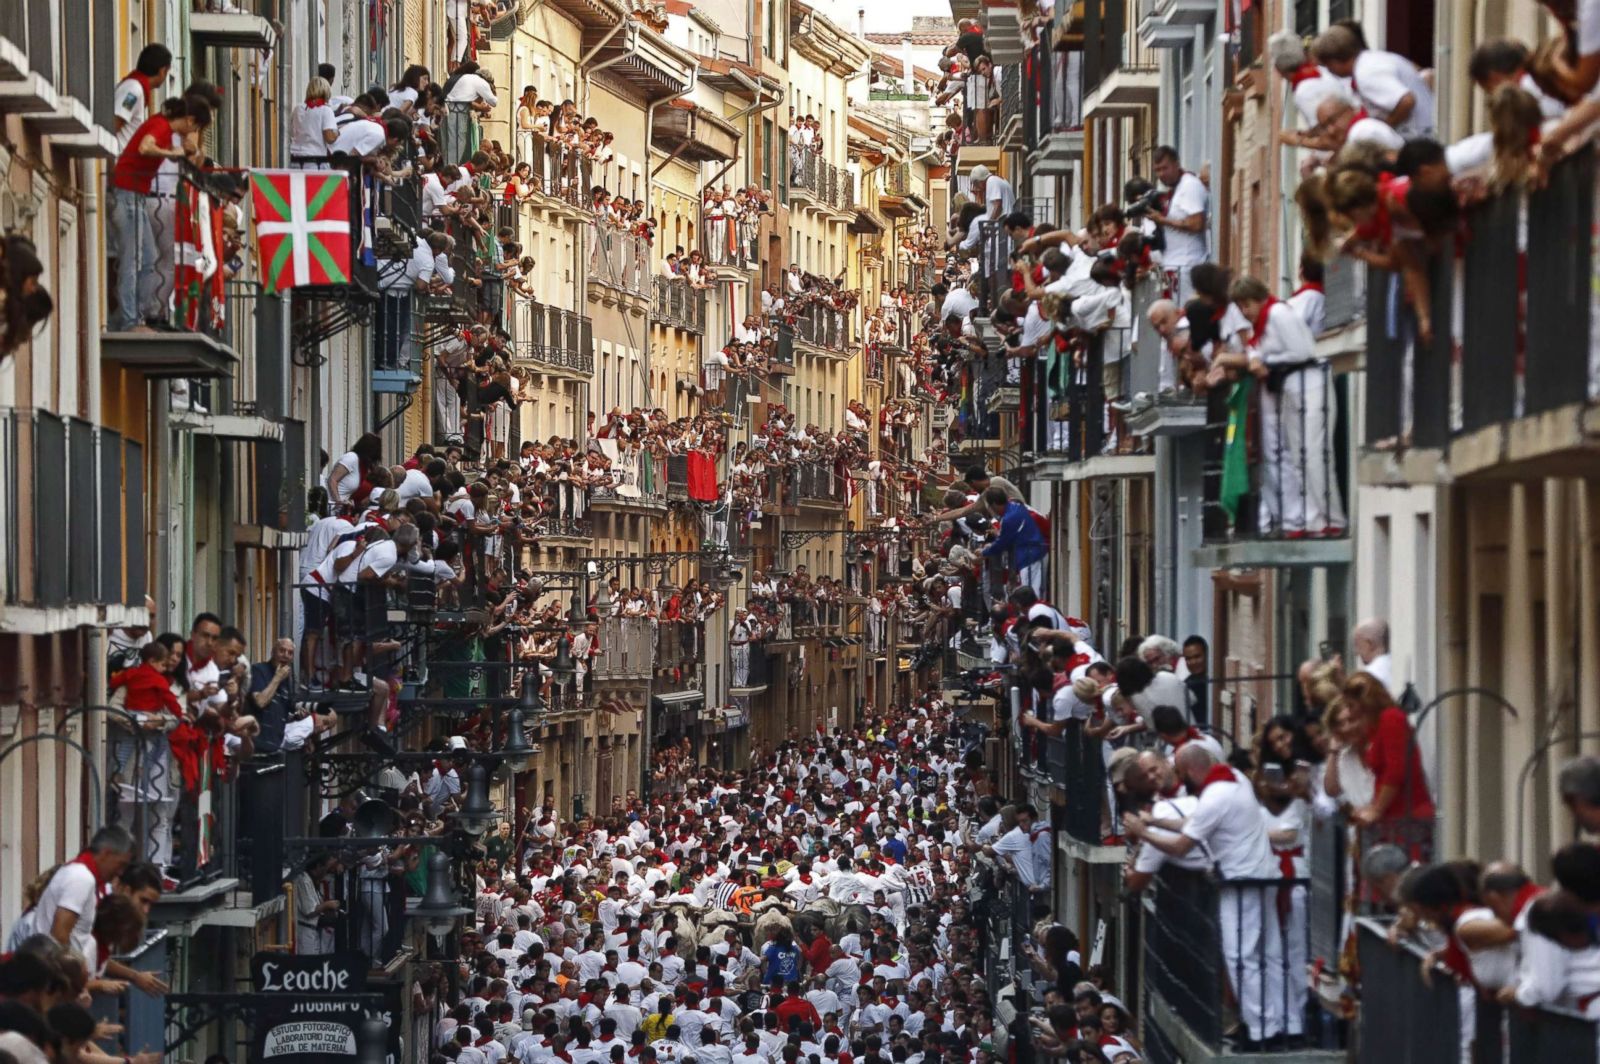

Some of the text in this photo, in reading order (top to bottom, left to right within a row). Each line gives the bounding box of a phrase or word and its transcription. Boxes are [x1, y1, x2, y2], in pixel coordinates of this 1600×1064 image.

[262, 961, 349, 992] Leache
[271, 1024, 301, 1037] ESTUDIO
[275, 1033, 348, 1045] LABORATORIO COLOR
[271, 1043, 348, 1055] VENTA DE MATERIAL
